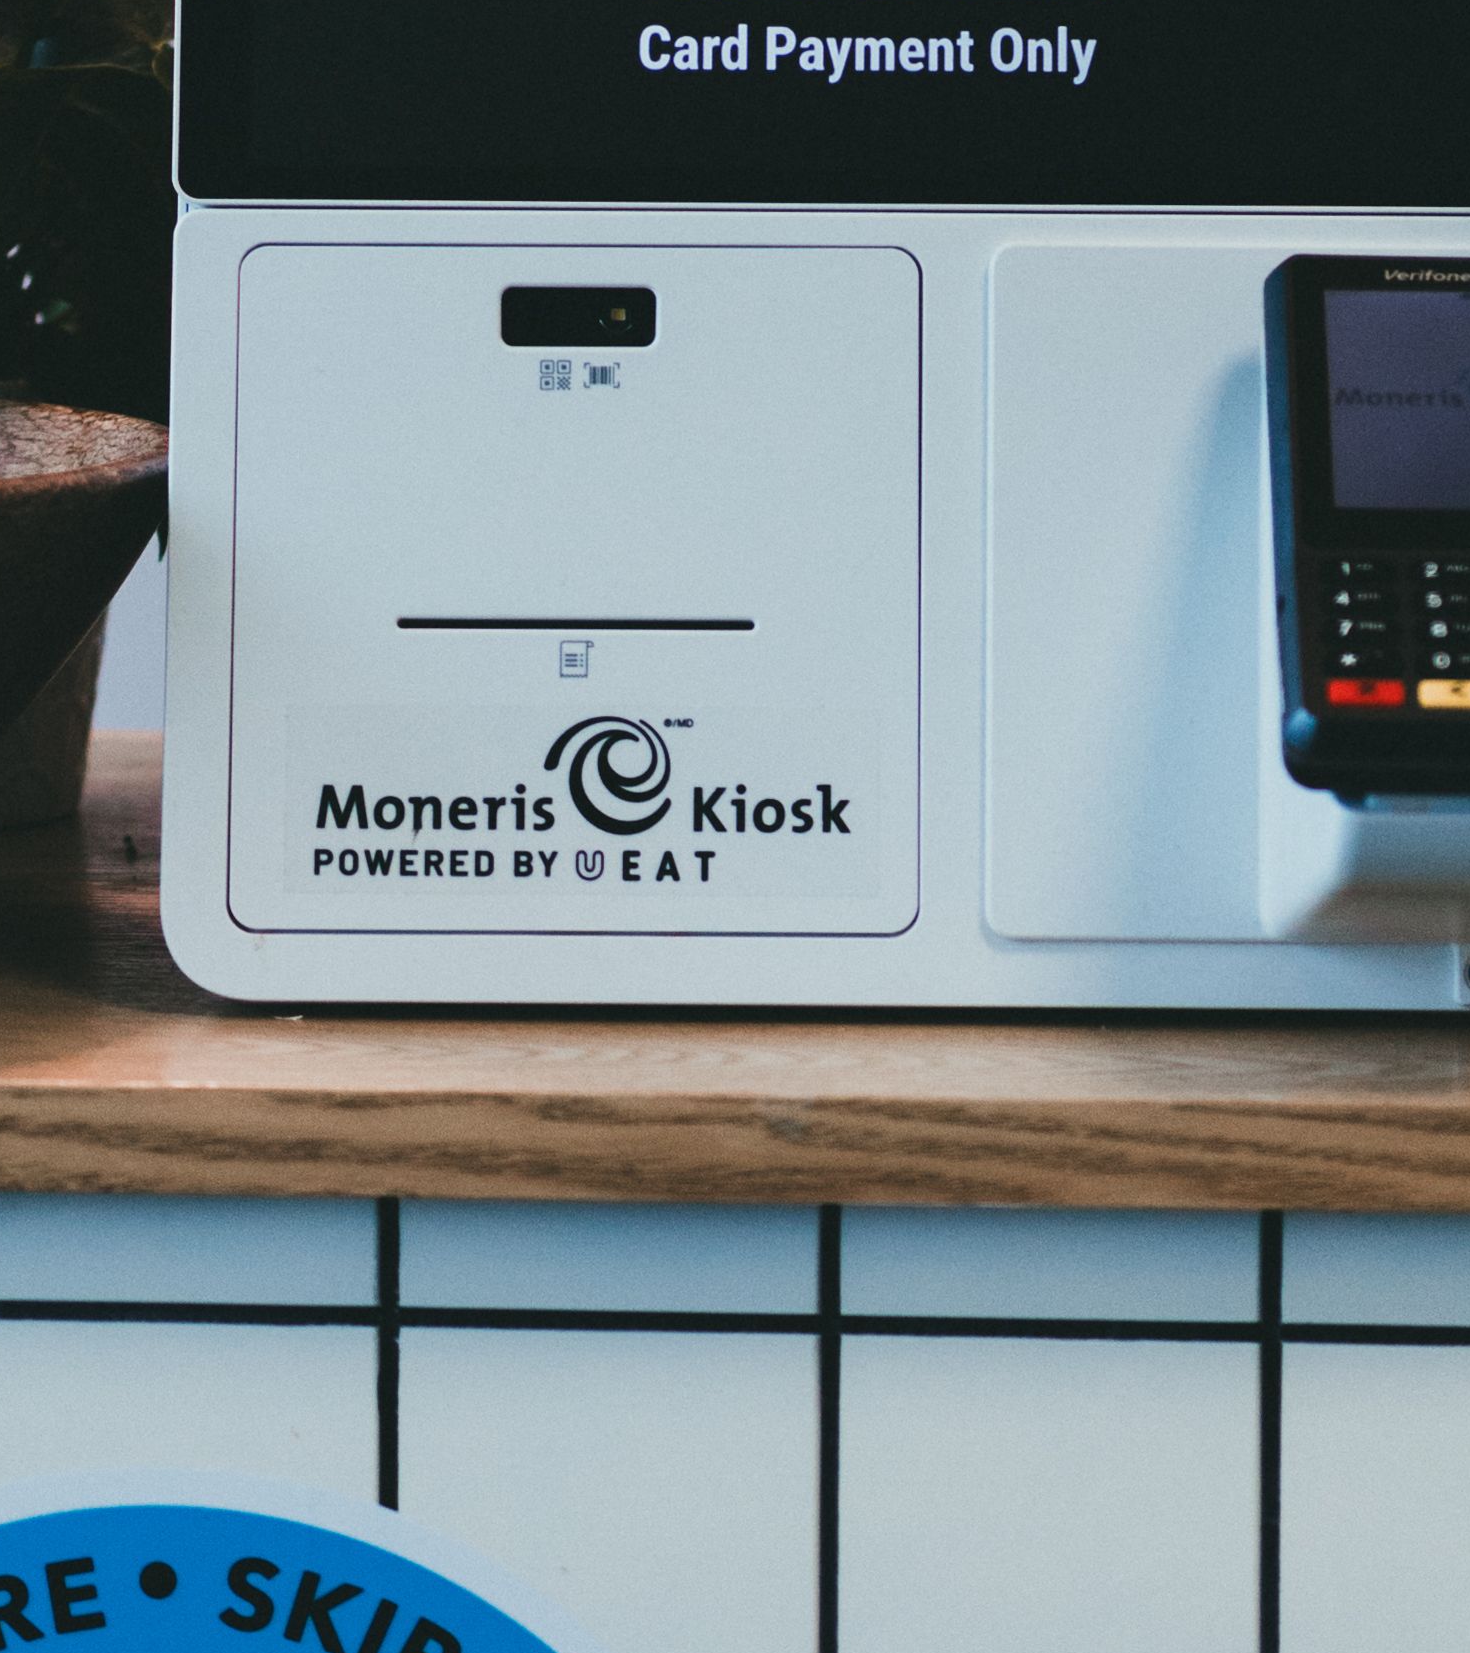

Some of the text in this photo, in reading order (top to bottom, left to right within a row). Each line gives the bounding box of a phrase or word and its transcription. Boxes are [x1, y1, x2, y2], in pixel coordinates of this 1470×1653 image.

[639, 24, 1097, 84] Card Payment Only
[316, 784, 850, 833] Moneris Kiosk
[314, 849, 494, 877] POWERED
[514, 851, 558, 877] BY
